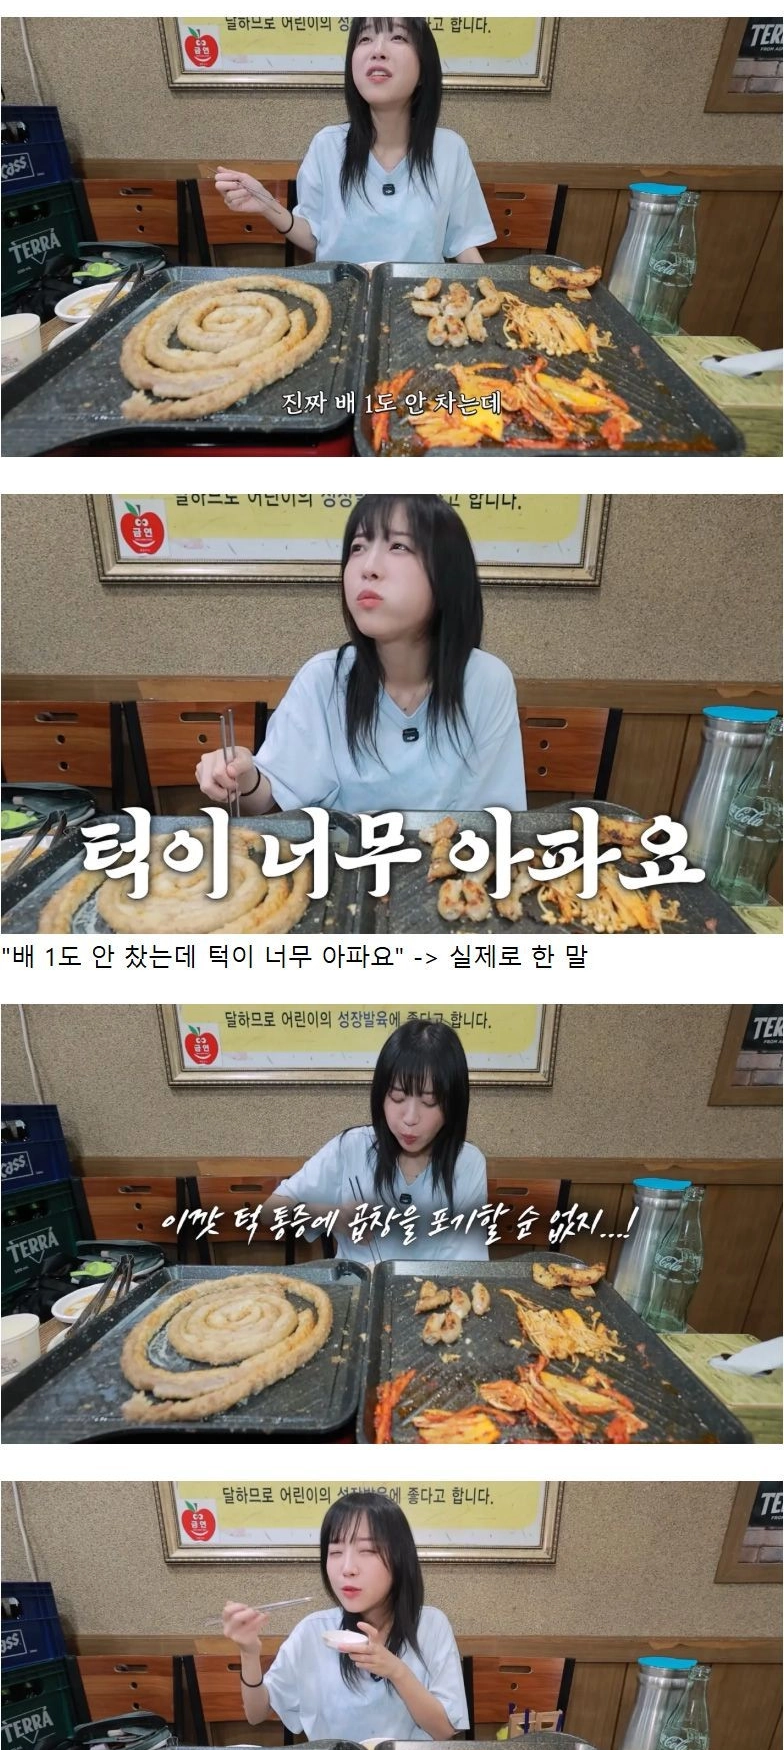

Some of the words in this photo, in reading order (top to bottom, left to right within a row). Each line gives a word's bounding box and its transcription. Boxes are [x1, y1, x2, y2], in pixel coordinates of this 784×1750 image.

[8, 232, 61, 264] TERRA
[225, 1010, 276, 1029] 달하므로
[281, 1010, 332, 1029] 어린이의
[338, 1010, 400, 1029] 성장발육에
[451, 1010, 491, 1029] 합니다.
[6, 1231, 59, 1263] TERRA
[222, 1486, 274, 1504] 달하므로
[280, 1486, 331, 1504] 어린이의
[407, 1486, 445, 1504] 좋다고
[452, 1487, 494, 1505] 합니다.
[1, 1711, 54, 1743] TERRA
